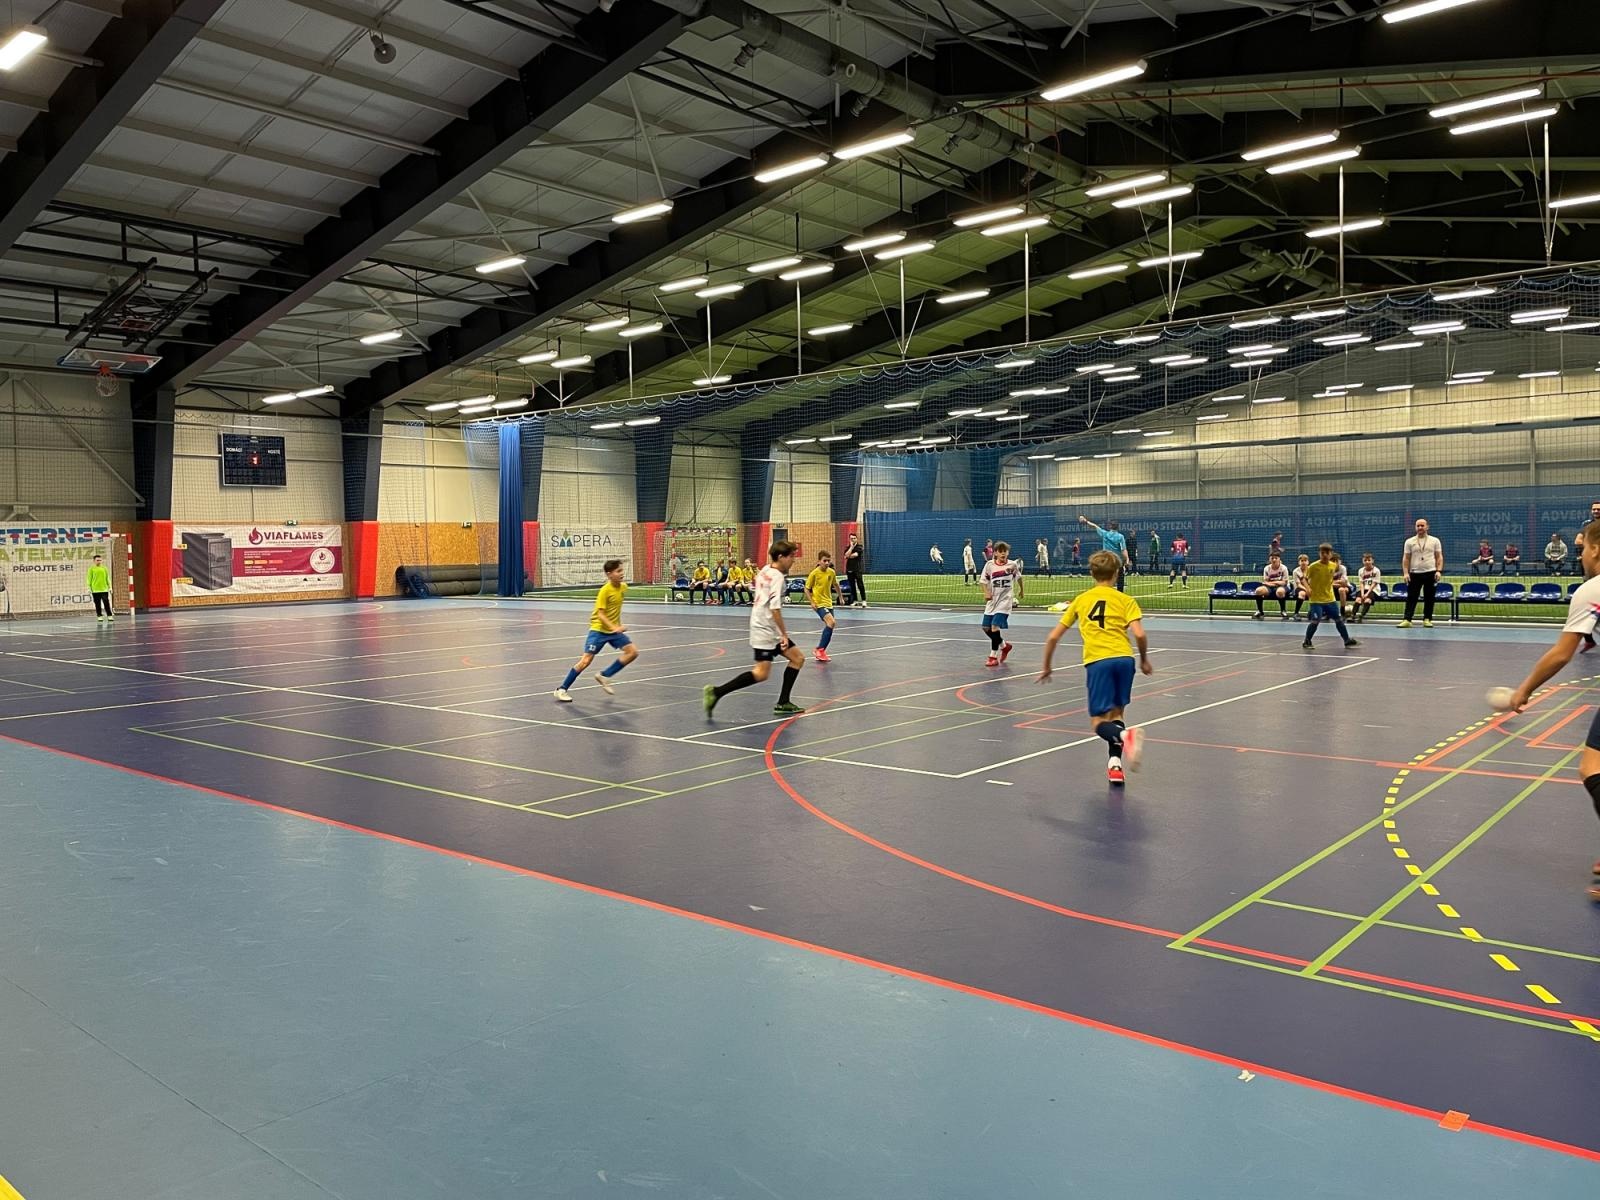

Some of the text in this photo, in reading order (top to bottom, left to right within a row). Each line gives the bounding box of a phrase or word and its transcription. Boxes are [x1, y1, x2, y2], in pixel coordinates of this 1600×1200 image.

[1453, 511, 1511, 523] PENZION
[1541, 509, 1590, 521] ADVEN
[1238, 517, 1292, 528] STADION
[264, 531, 324, 540] VIAFLAMES
[15, 546, 107, 561] TELEVIZE
[13, 564, 73, 573] PŘIPOJTE SE!
[62, 594, 93, 604] POD
[1088, 600, 1107, 629] 4
